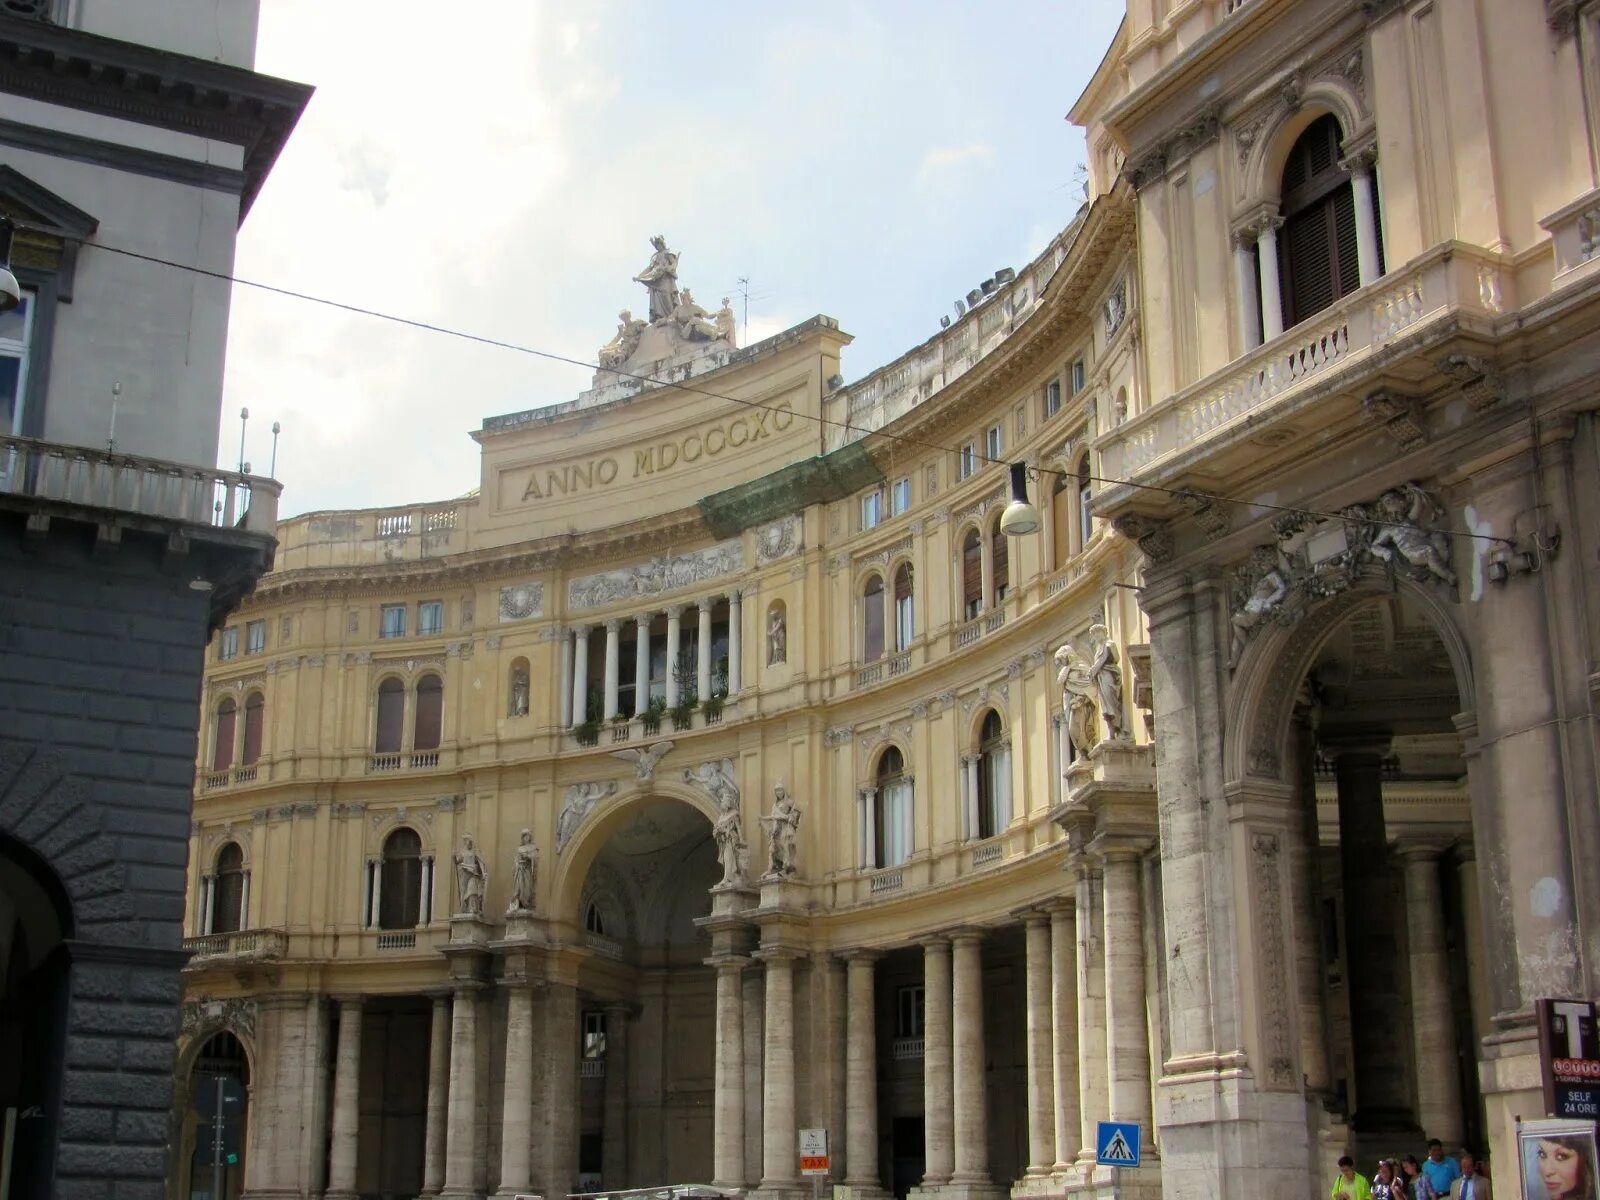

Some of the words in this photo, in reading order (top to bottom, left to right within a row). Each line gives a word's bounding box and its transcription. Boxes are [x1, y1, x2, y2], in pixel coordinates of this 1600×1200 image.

[521, 458, 618, 501] ANNO
[632, 401, 794, 478] MDCCCXC
[1554, 1002, 1590, 1058] T
[1553, 1060, 1600, 1074] LOTTO
[1568, 1091, 1591, 1101] SELF
[1565, 1103, 1575, 1113] 24
[1577, 1104, 1597, 1113] ORE
[803, 1159, 828, 1169] TAXI
